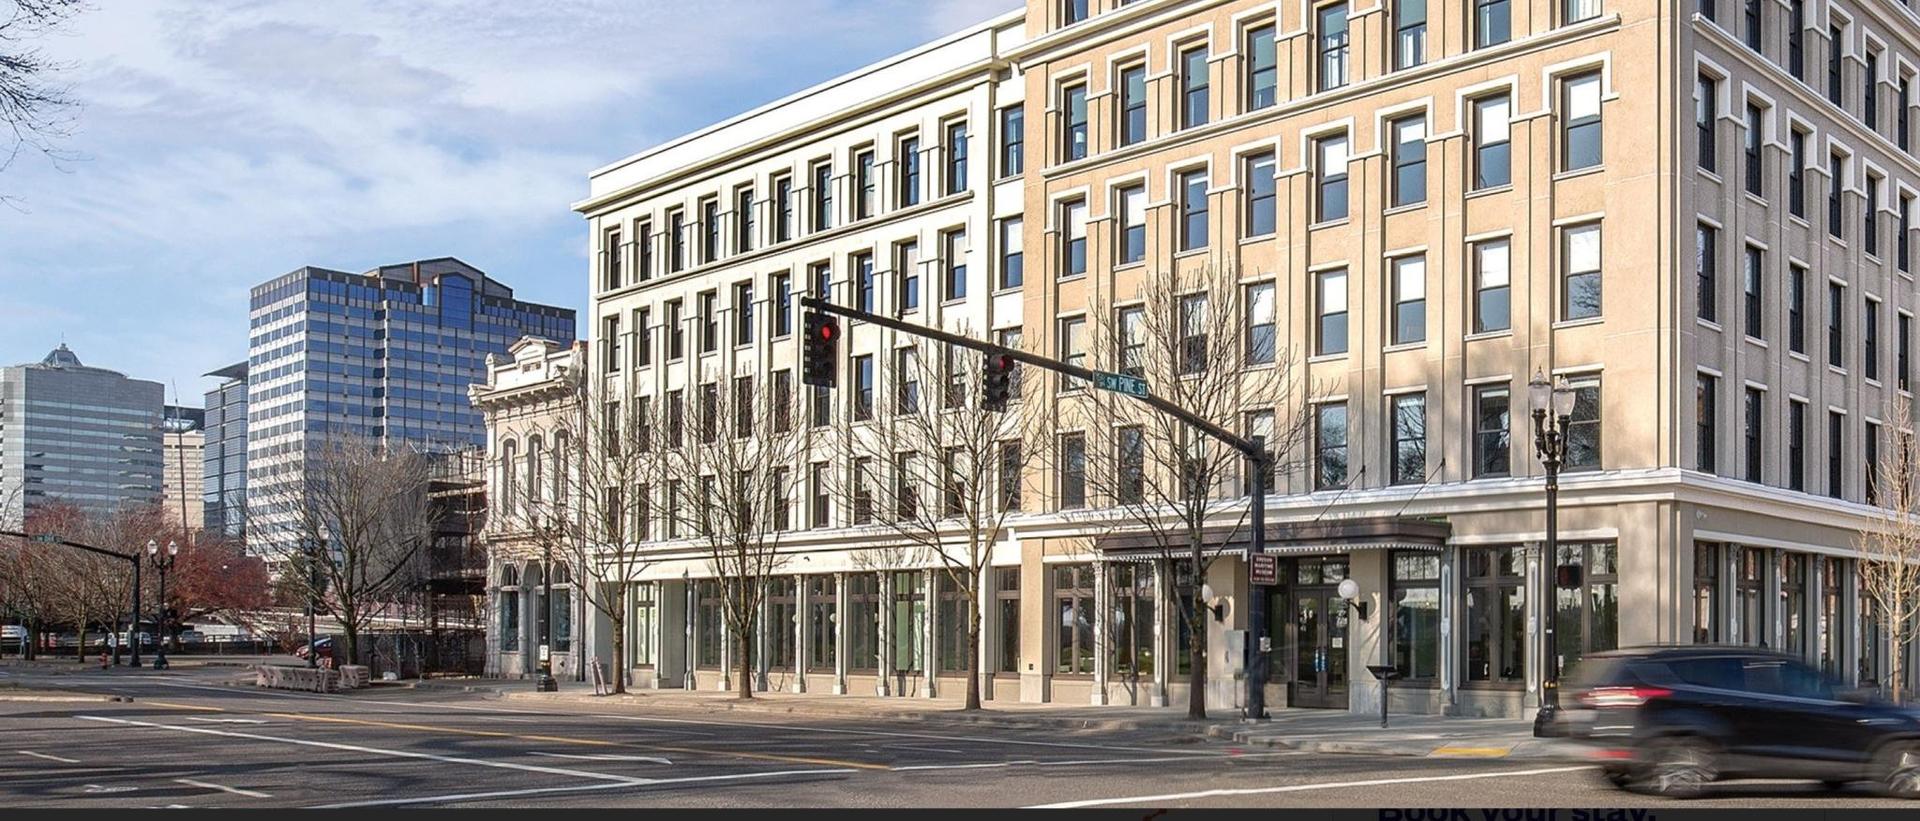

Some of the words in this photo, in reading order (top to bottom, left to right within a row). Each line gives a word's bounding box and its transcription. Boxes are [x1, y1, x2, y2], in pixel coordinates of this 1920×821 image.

[1106, 376, 1117, 389] SW
[1118, 376, 1136, 393] PINE
[1137, 382, 1146, 395] ST
